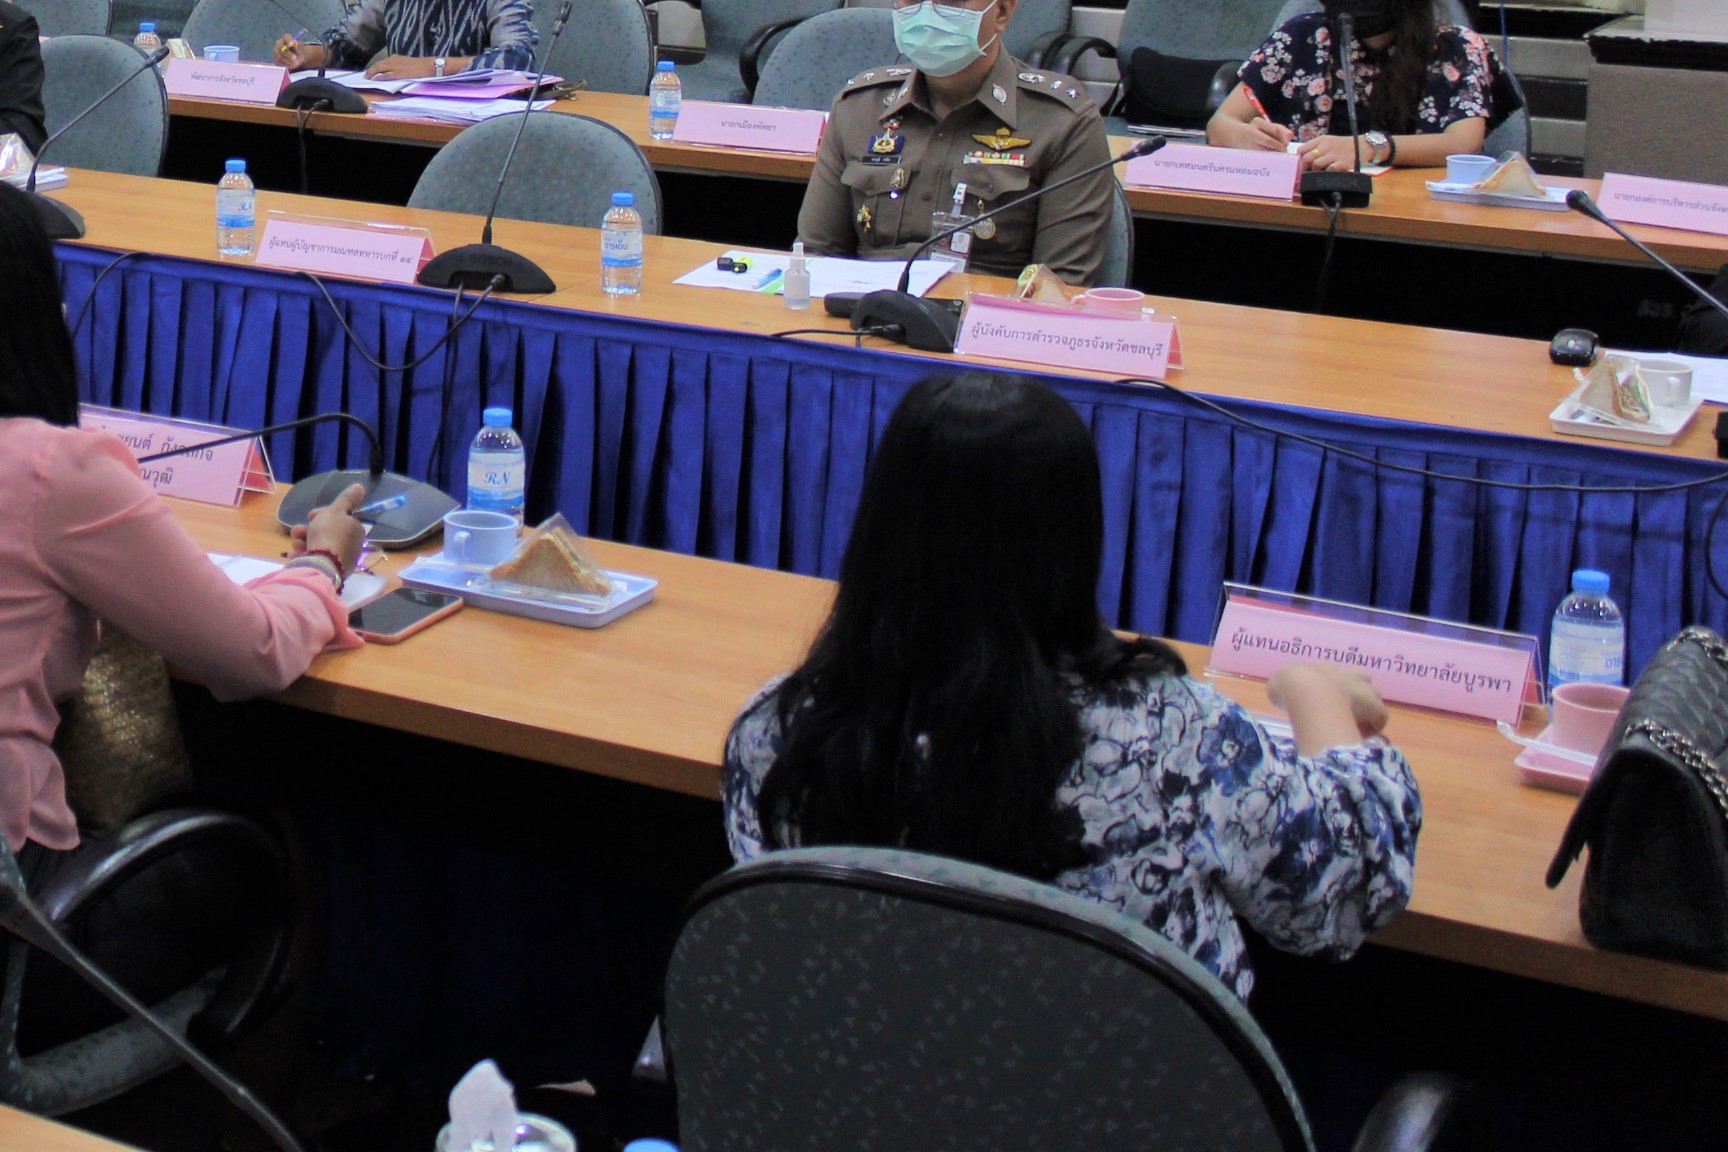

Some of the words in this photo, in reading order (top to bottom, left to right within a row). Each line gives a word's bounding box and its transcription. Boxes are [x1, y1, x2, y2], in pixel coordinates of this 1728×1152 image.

[720, 119, 776, 132] นายกเมืองพัทยา
[970, 321, 1164, 360] ผู้บังคับการตำรวจภูธรจังหวัดชลบุรี
[1231, 626, 1512, 693] ผู้แทนอธิการบดีมหาวิทยาลัยบูรพา
